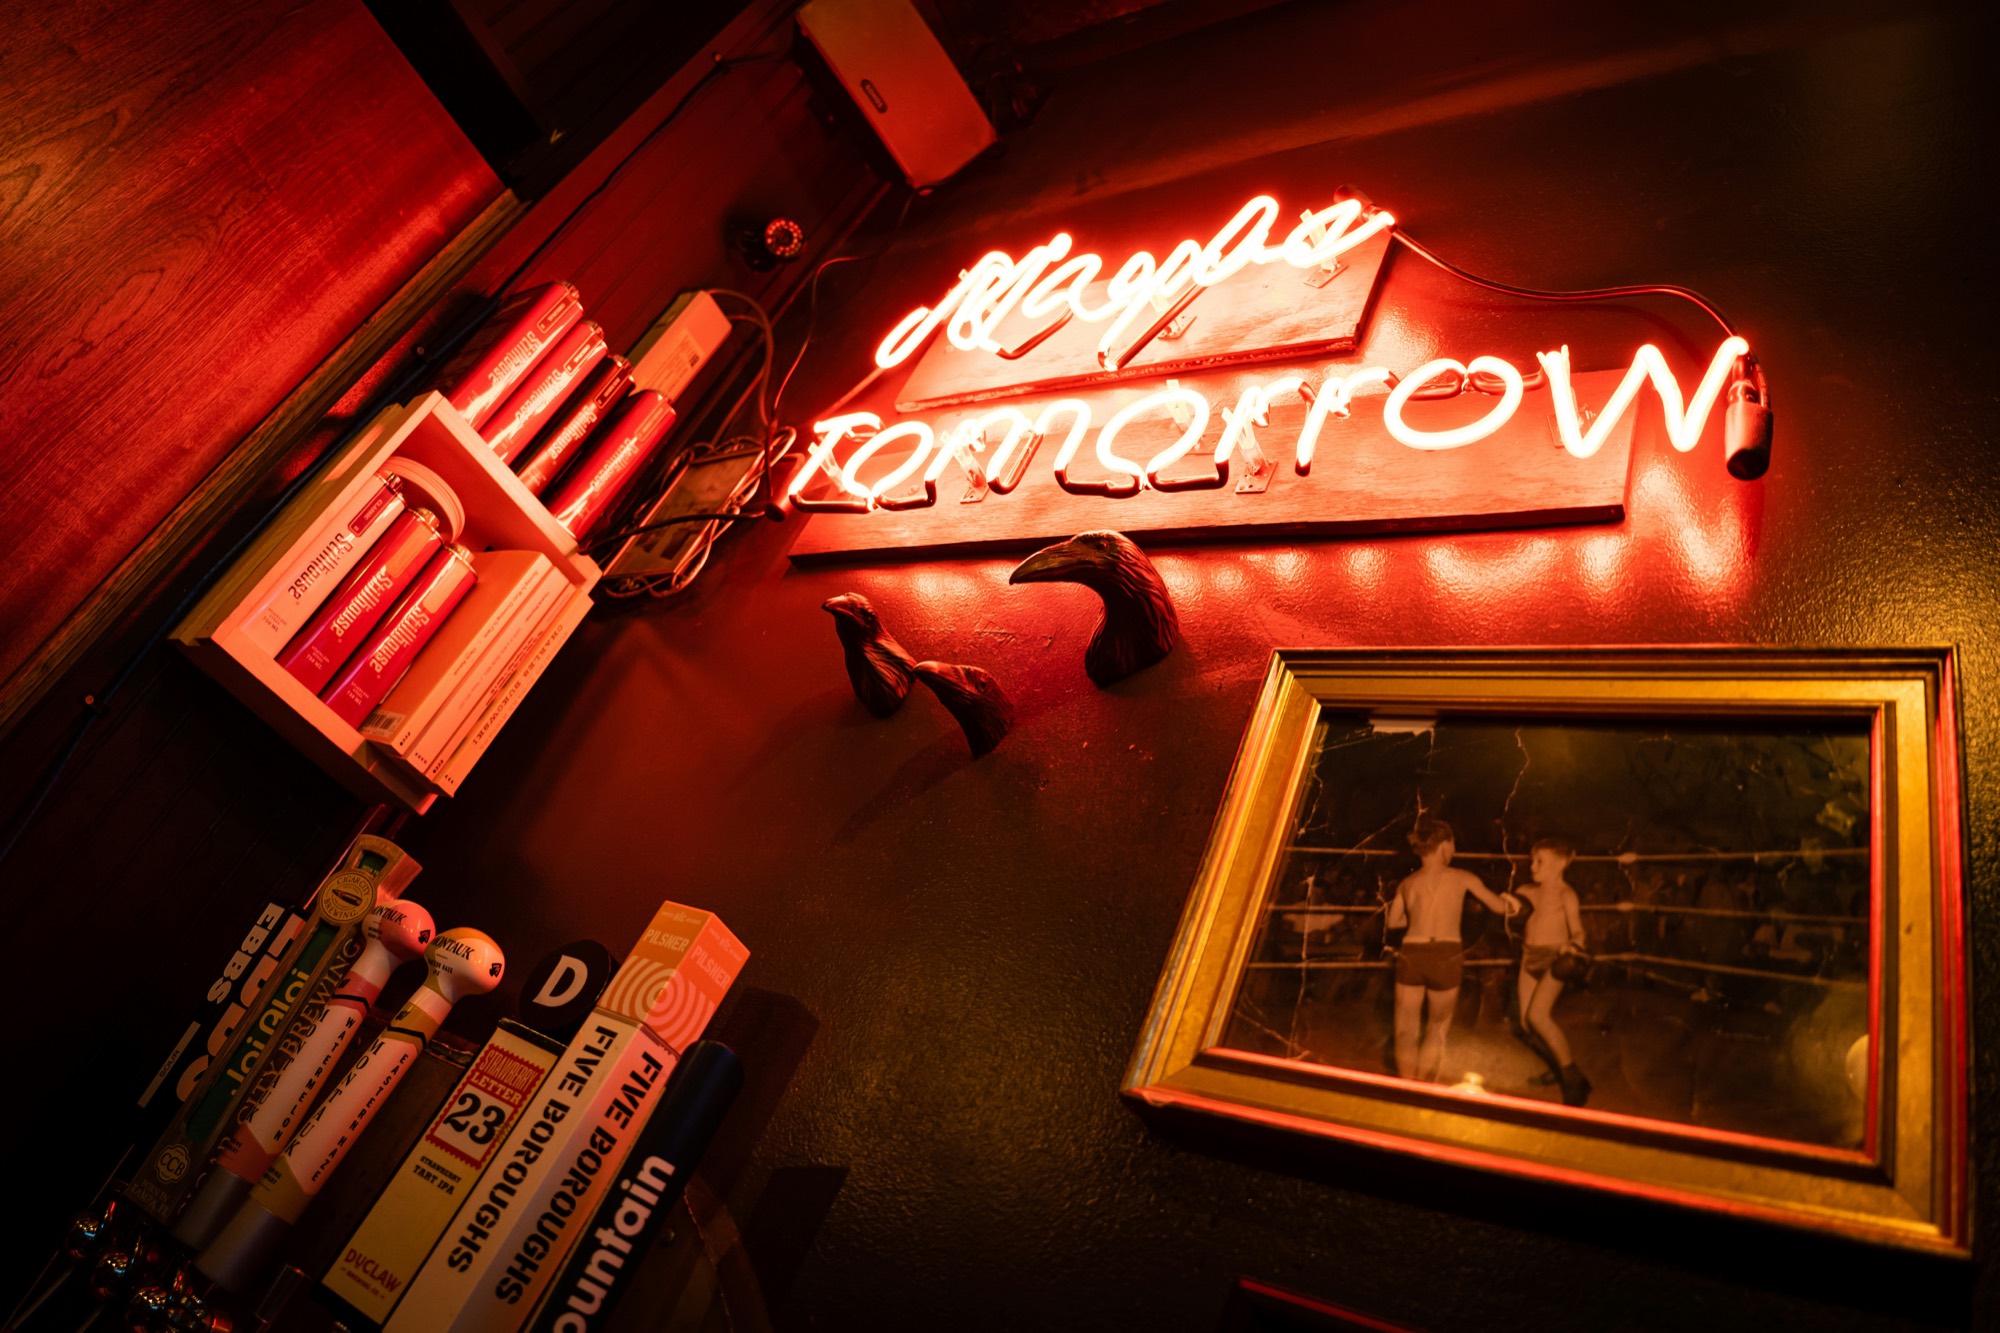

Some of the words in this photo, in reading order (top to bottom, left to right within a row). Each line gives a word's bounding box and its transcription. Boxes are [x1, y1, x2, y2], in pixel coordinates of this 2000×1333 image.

[550, 405, 597, 459] Stillhouse
[363, 499, 383, 521] CLASSIC
[288, 533, 353, 600] Stillhouse
[331, 567, 393, 637] Stillhouse
[369, 606, 430, 673] Stillhouse
[521, 623, 565, 679] CHARLES
[470, 679, 523, 746] BUKOWSKI
[322, 898, 358, 919] BREWING
[206, 901, 285, 1005] EBBS
[642, 928, 690, 953] PILSNER
[532, 954, 588, 1007] D
[690, 944, 732, 991] PILSNER
[159, 1049, 181, 1080] SOUR
[273, 1017, 356, 1141] WATERMELON
[470, 1071, 523, 1105] LETTER
[479, 1049, 539, 1093] STRAWBERRY
[557, 1025, 619, 1098] FIVE
[285, 1039, 384, 1157] MONTAUK
[349, 1053, 409, 1132] EASTERN
[604, 1051, 663, 1131] FIVE
[443, 1092, 506, 1145] 23
[160, 1152, 186, 1176] CCB
[311, 1136, 348, 1182] HAZE
[412, 1164, 438, 1185] TART
[436, 1177, 455, 1196] IPA
[420, 1155, 462, 1184] STRAWBERRY
[448, 1098, 570, 1273] BOROUGHS
[495, 1125, 617, 1305] BOROUGHS
[344, 1248, 402, 1293] DUCLAW
